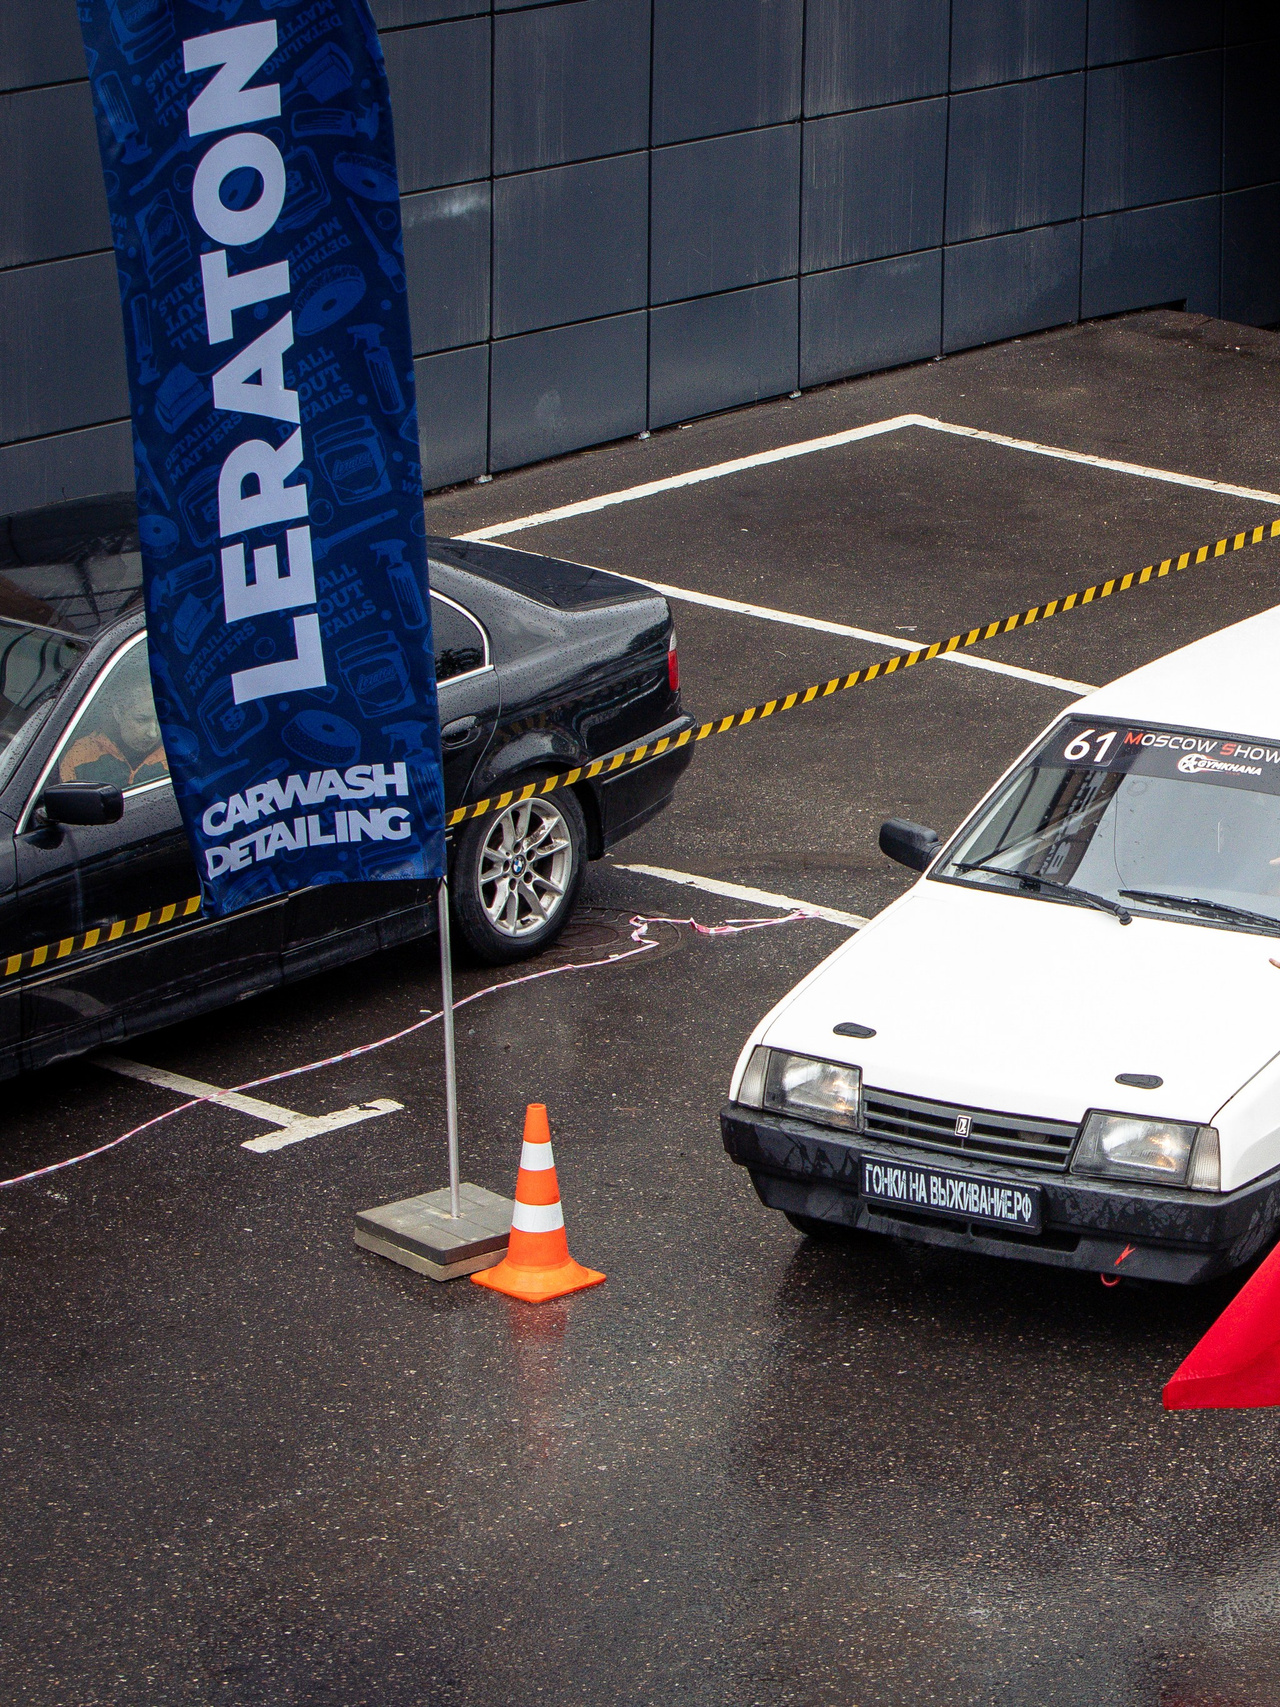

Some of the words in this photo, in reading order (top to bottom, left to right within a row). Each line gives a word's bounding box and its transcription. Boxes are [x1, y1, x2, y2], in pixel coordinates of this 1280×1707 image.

[183, 19, 327, 706] LERATON
[1063, 728, 1118, 763] 61
[1123, 731, 1218, 753] MOSCOW
[1197, 760, 1263, 776] GYMKHANA
[202, 761, 410, 838] CARWASH
[204, 806, 412, 881] DETAILING
[864, 1162, 907, 1200] ГОНКИ
[909, 1171, 928, 1204] НА
